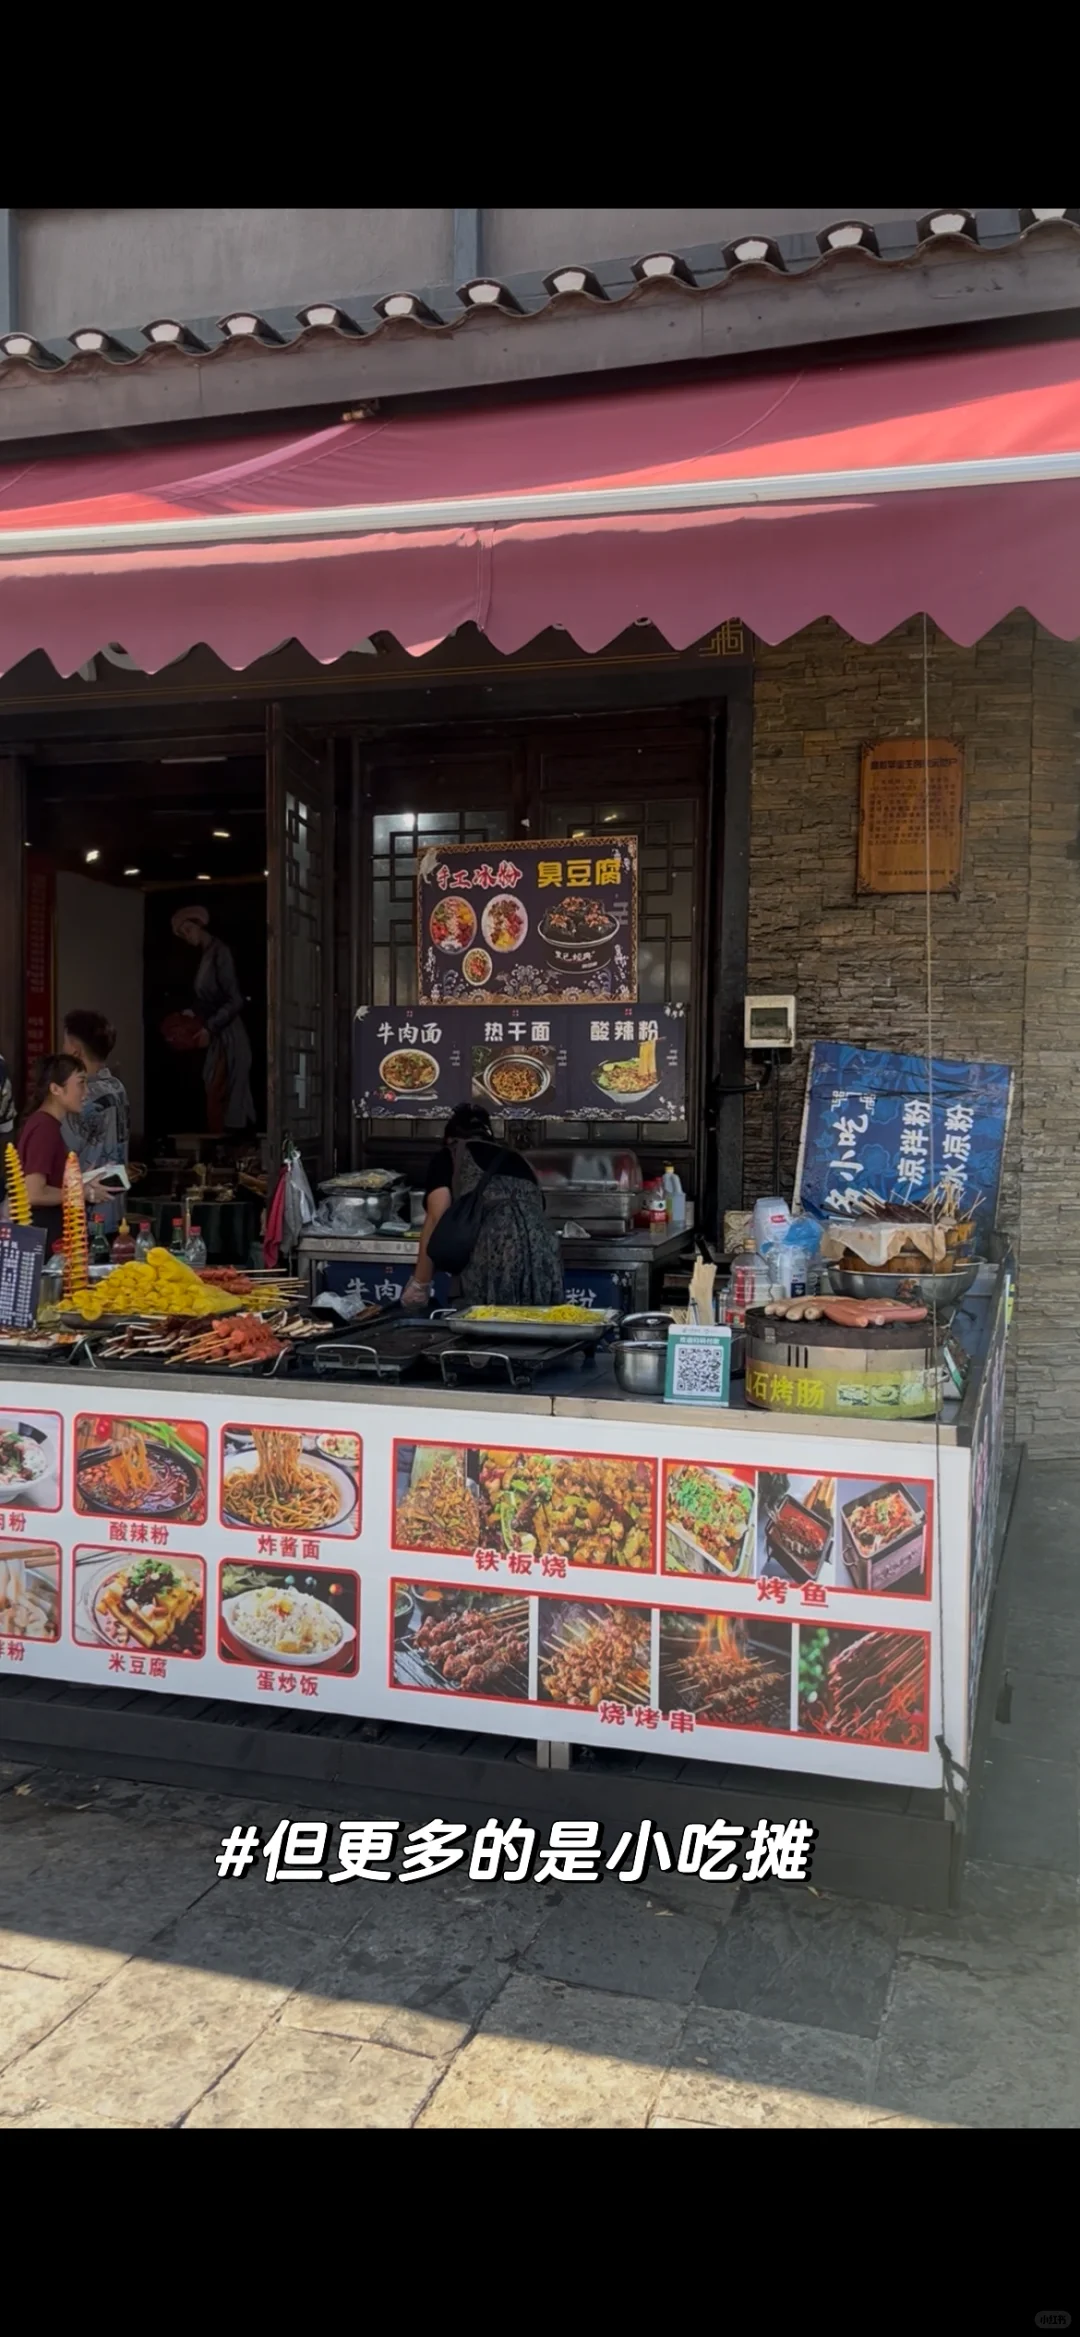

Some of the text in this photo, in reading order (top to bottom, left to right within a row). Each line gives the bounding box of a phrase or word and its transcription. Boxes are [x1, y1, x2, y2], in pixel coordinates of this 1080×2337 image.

[436, 859, 523, 891] 手工冰粉
[538, 858, 622, 888] 臭豆腐
[376, 1022, 443, 1045] 牛肉面
[484, 1020, 551, 1042] 热干面
[590, 1020, 659, 1042] 酸辣粉
[897, 1099, 932, 1187] 凉拌粉
[109, 1520, 170, 1545] 酸辣粉
[257, 1534, 322, 1560] 炸酱面
[475, 1548, 568, 1580] 铁板烧
[756, 1575, 830, 1609] 烤鱼
[0, 1639, 26, 1662] 粉
[108, 1652, 168, 1679] 米豆腐
[256, 1670, 320, 1697] 蛋炒饭
[598, 1699, 697, 1735] 烧烤串
